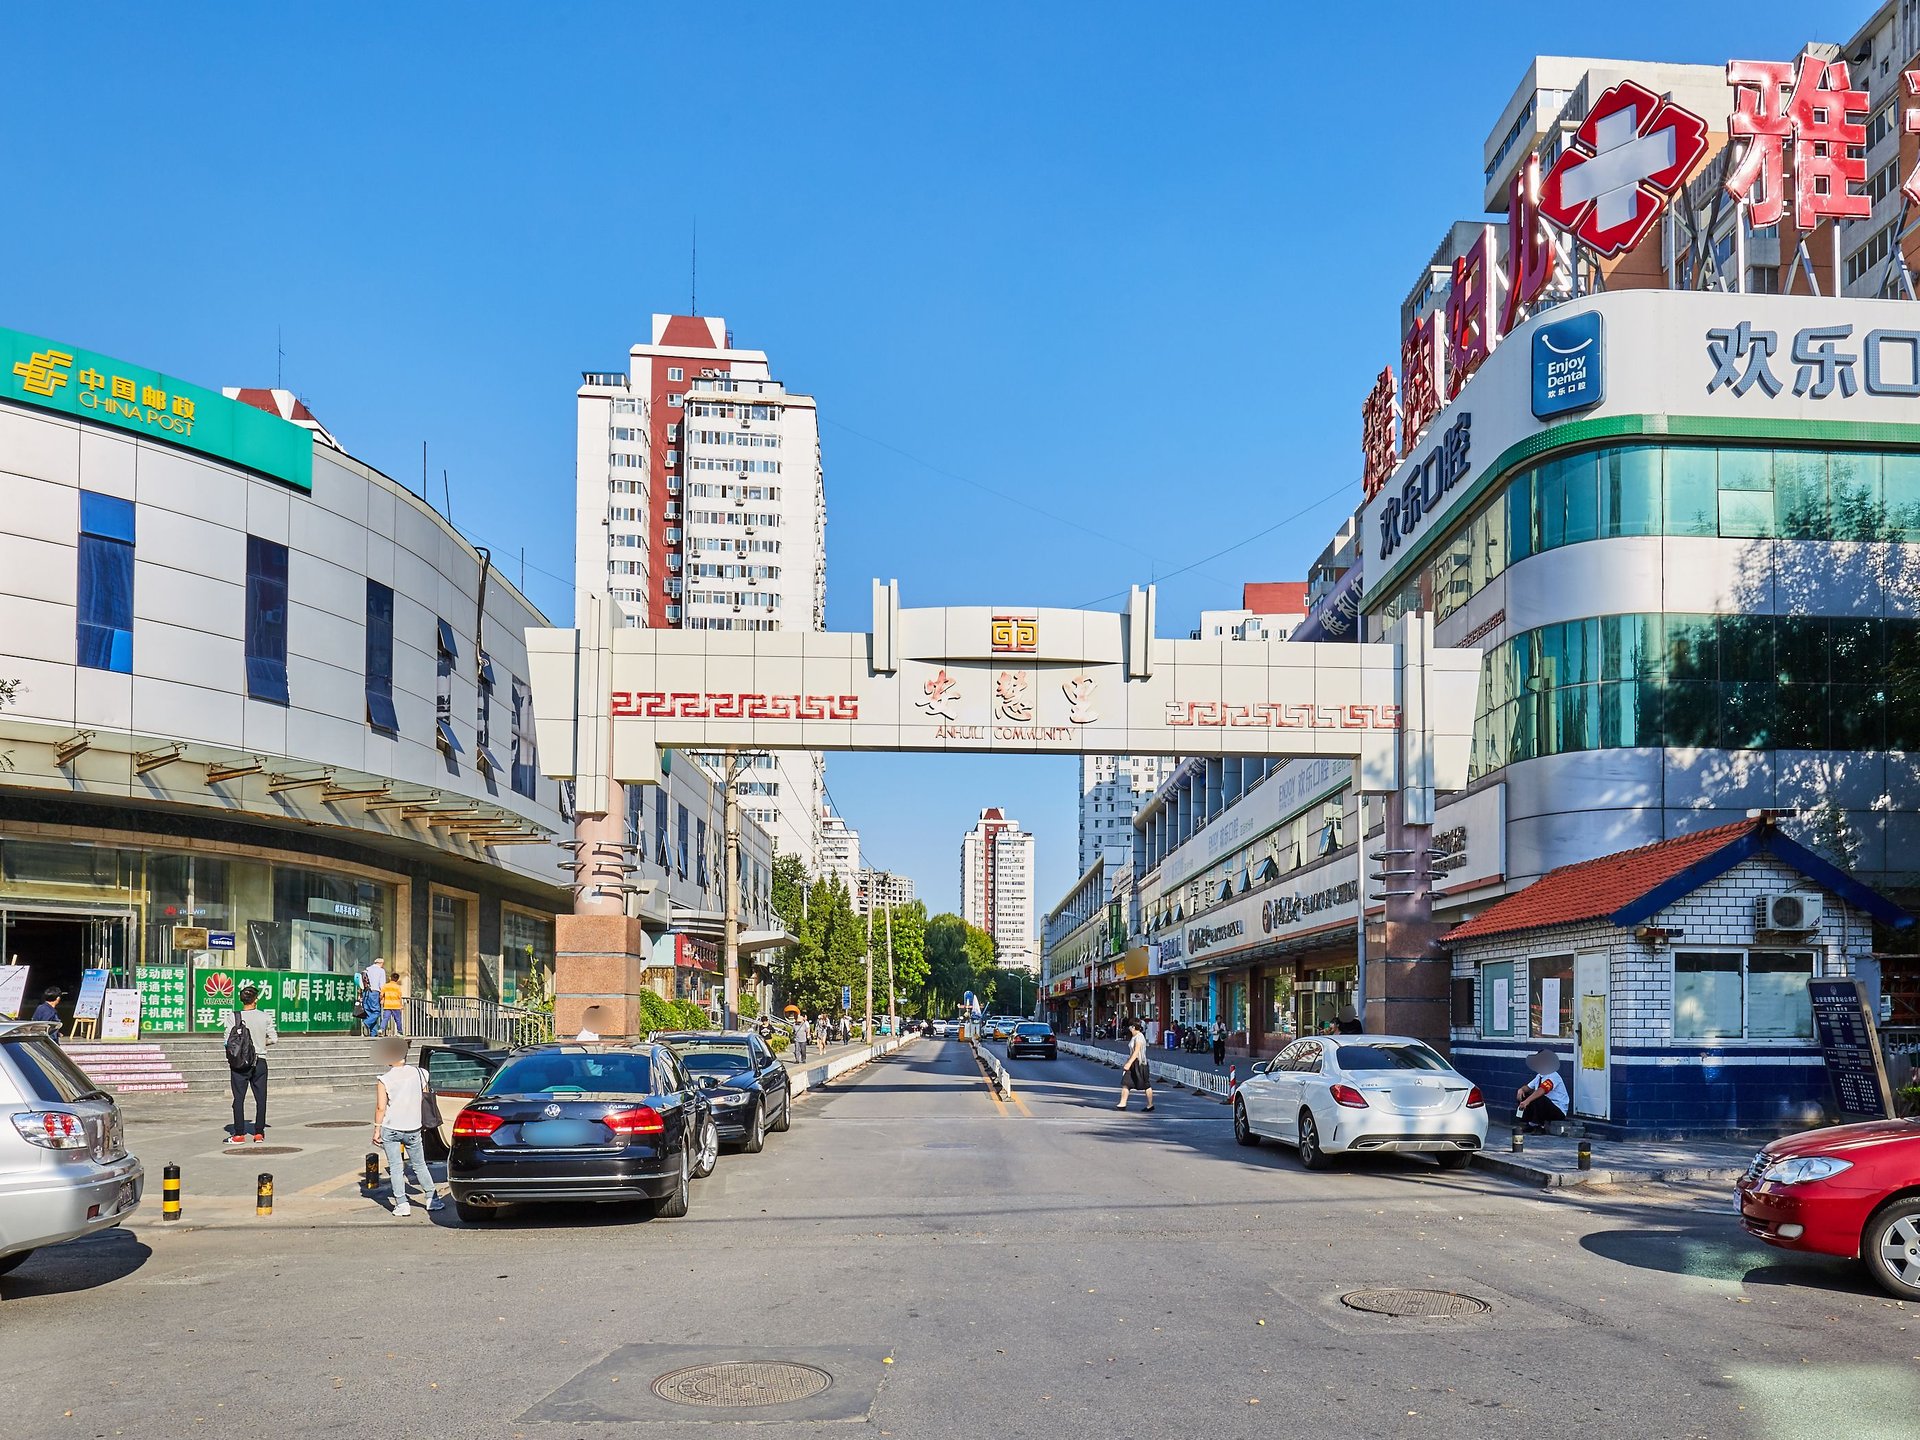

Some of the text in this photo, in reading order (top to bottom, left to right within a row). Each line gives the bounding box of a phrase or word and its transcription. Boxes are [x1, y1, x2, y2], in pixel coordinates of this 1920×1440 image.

[1548, 355, 1586, 376] Enjoy
[1548, 366, 1587, 389] Dental
[79, 367, 196, 422] 中国邮政
[1548, 381, 1587, 398] 欢乐口腔
[79, 391, 195, 437] CHINA POST
[1379, 412, 1472, 560] 欢乐口腔
[935, 725, 1076, 742] ANHUILI COMMUNITY
[136, 968, 185, 980] 移动靓号
[136, 981, 185, 993] 联通卡号
[282, 977, 355, 1002] 邮局手机专卖
[141, 1020, 185, 1032] G上网卡
